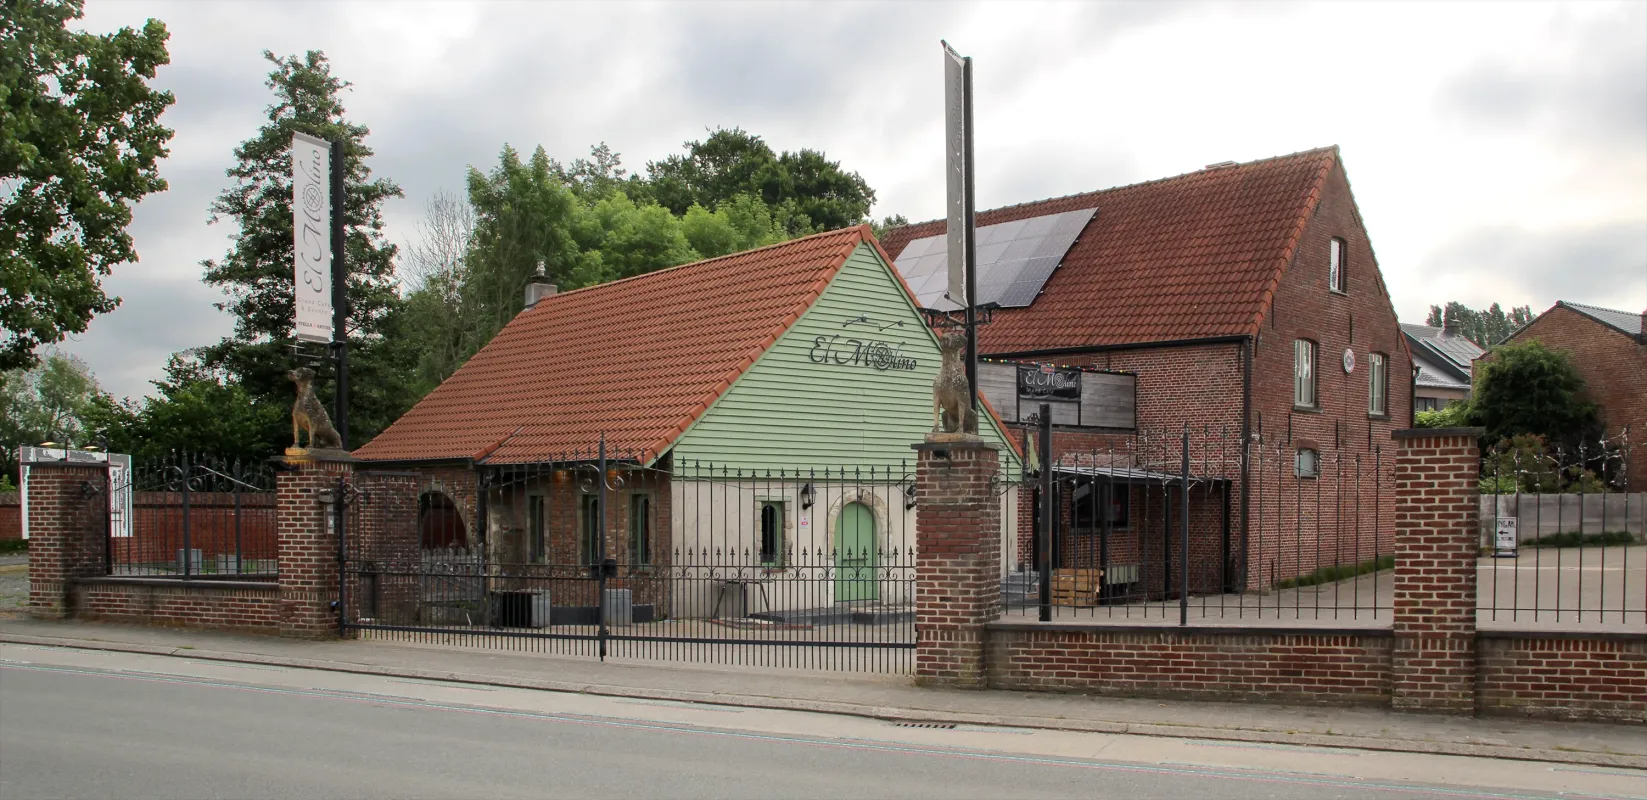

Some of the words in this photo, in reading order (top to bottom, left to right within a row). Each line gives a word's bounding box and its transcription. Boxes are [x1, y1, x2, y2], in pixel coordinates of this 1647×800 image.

[299, 149, 324, 262] Molino
[301, 252, 323, 293] El
[810, 334, 840, 363] El
[835, 339, 917, 371] Molino
[1025, 369, 1040, 385] El
[1037, 371, 1077, 389] Molino
